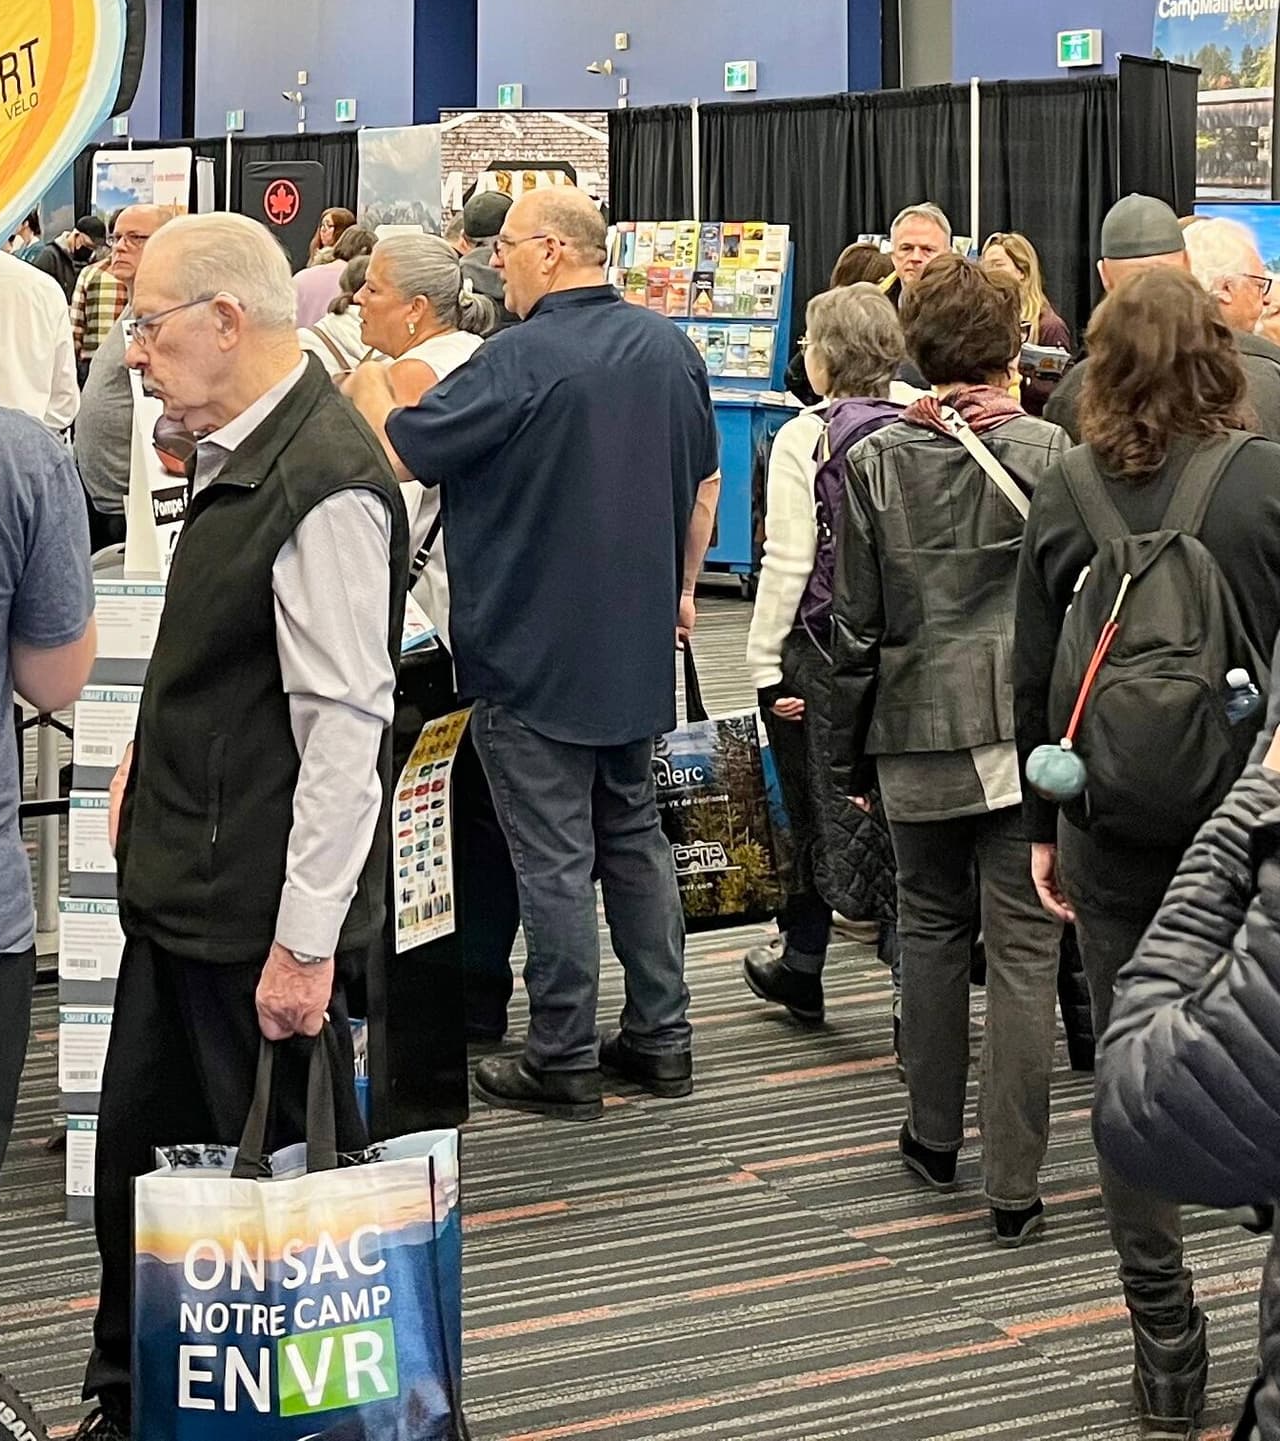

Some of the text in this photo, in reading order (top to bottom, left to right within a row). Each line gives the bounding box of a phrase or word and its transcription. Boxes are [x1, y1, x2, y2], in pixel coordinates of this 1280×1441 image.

[183, 1223, 388, 1292] ON SAC
[179, 1285, 392, 1337] NOTRE CAMP
[177, 1329, 390, 1413] EN VR
